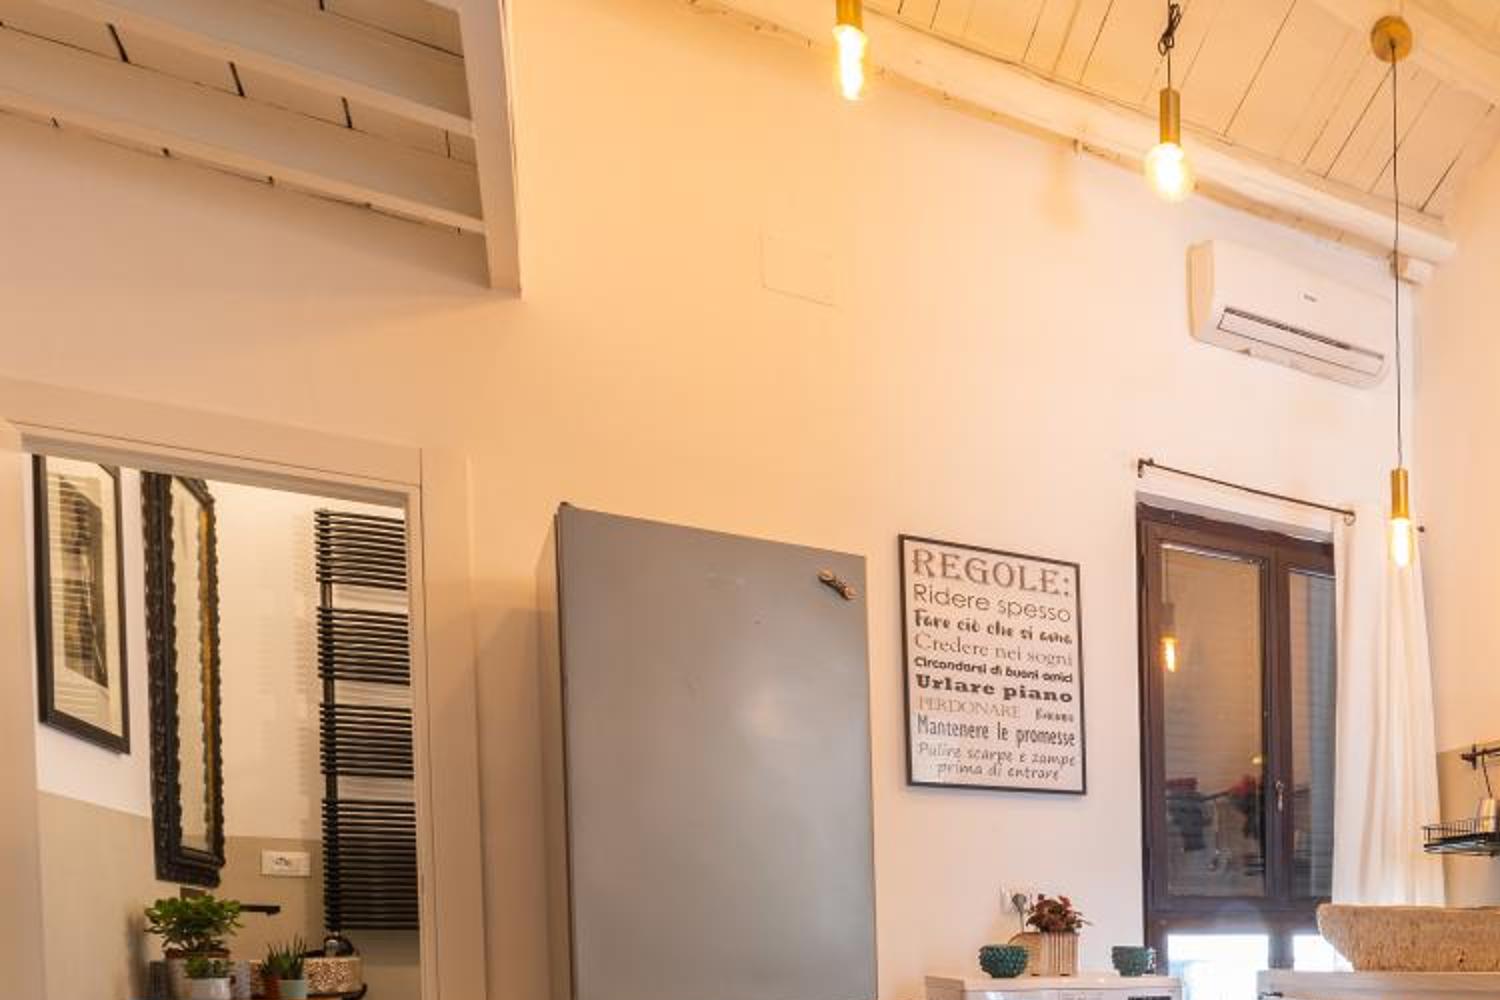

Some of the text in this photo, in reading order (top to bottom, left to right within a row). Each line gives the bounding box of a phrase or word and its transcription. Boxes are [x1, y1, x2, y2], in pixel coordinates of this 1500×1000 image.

[912, 549, 1070, 597] REGOLE:
[913, 583, 1071, 623] Ridere spesso
[914, 608, 951, 628] Fare
[987, 621, 1014, 637] che
[1021, 626, 1033, 640] si
[1039, 631, 1073, 645] ama
[914, 631, 1073, 667] Credere nei sogni
[914, 655, 1073, 683] Circondarsi di buoni amici
[915, 674, 1073, 703] Urlare piano
[918, 695, 1020, 719] PERDONARE
[917, 713, 1075, 748] Mantenere le promesse
[918, 741, 1076, 768] Pulire scarpe e zampe
[937, 760, 1059, 780] prima di entrare
